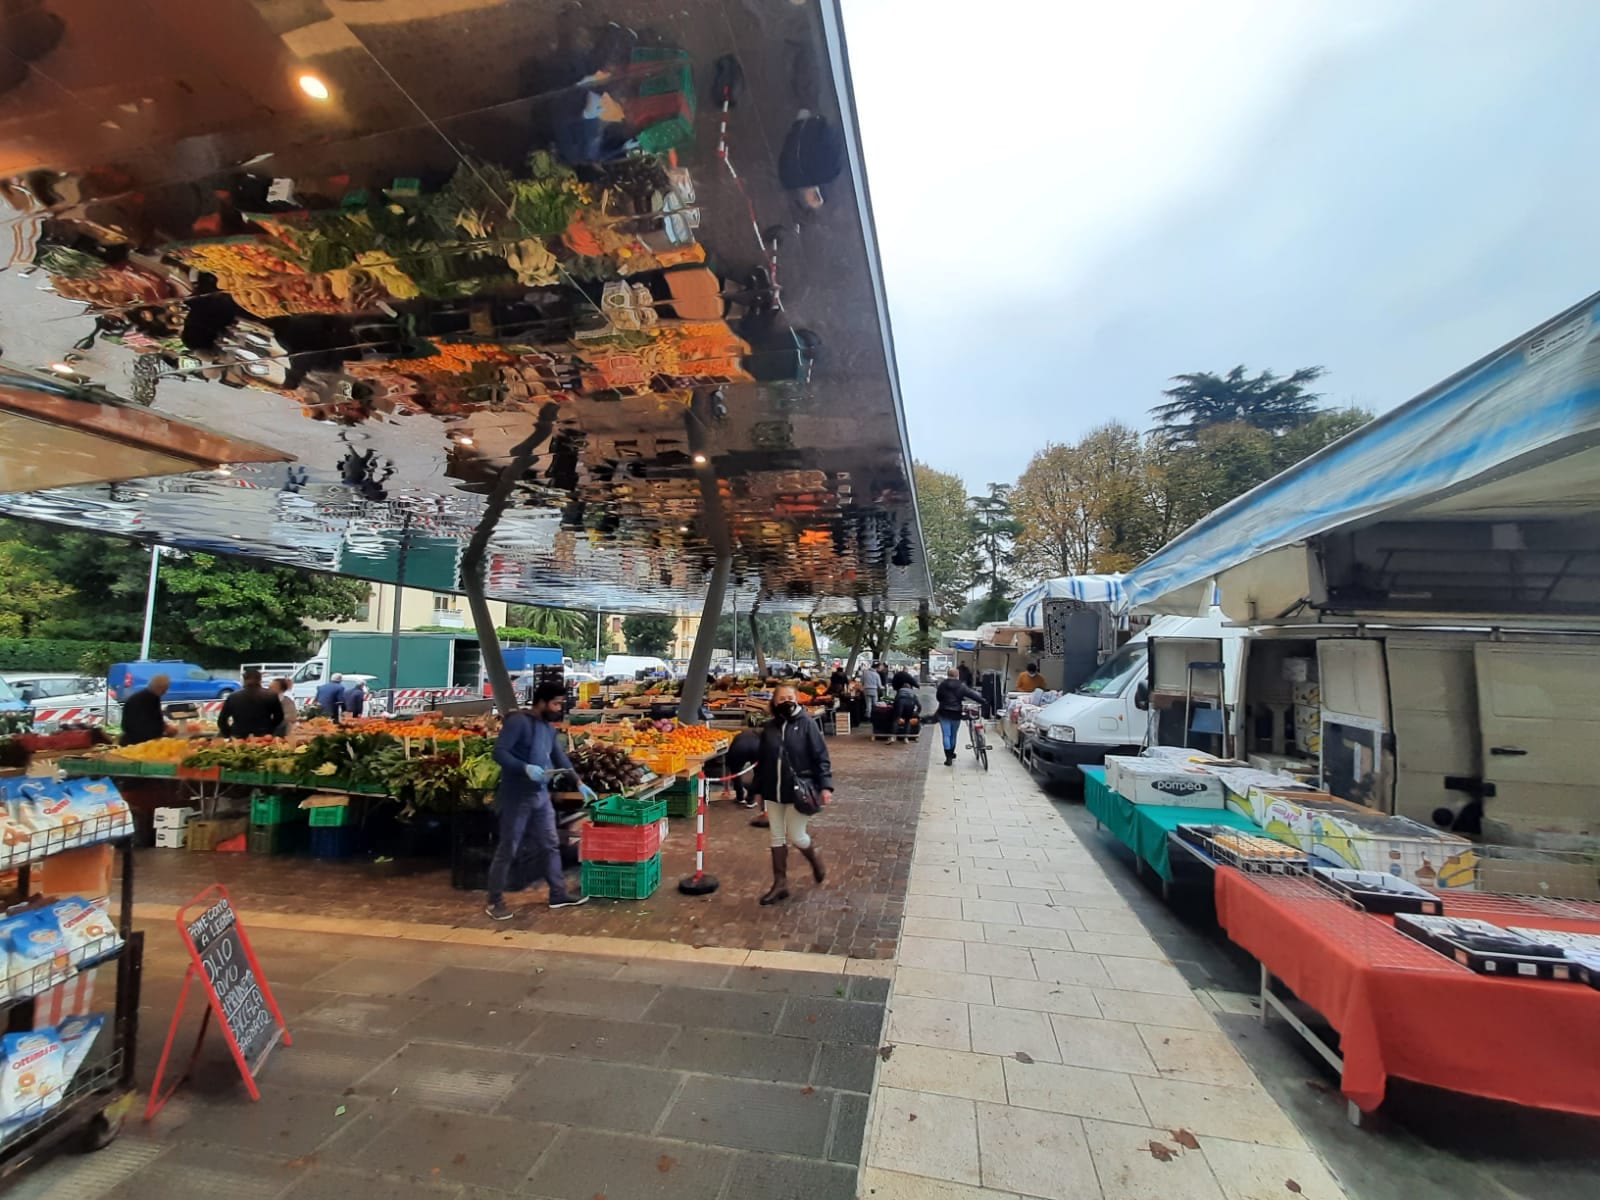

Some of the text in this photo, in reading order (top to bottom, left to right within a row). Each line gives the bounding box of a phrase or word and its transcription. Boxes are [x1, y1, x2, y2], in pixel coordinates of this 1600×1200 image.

[1157, 781, 1202, 791] pompea
[201, 934, 210, 946] A
[202, 938, 233, 984] OLIO
